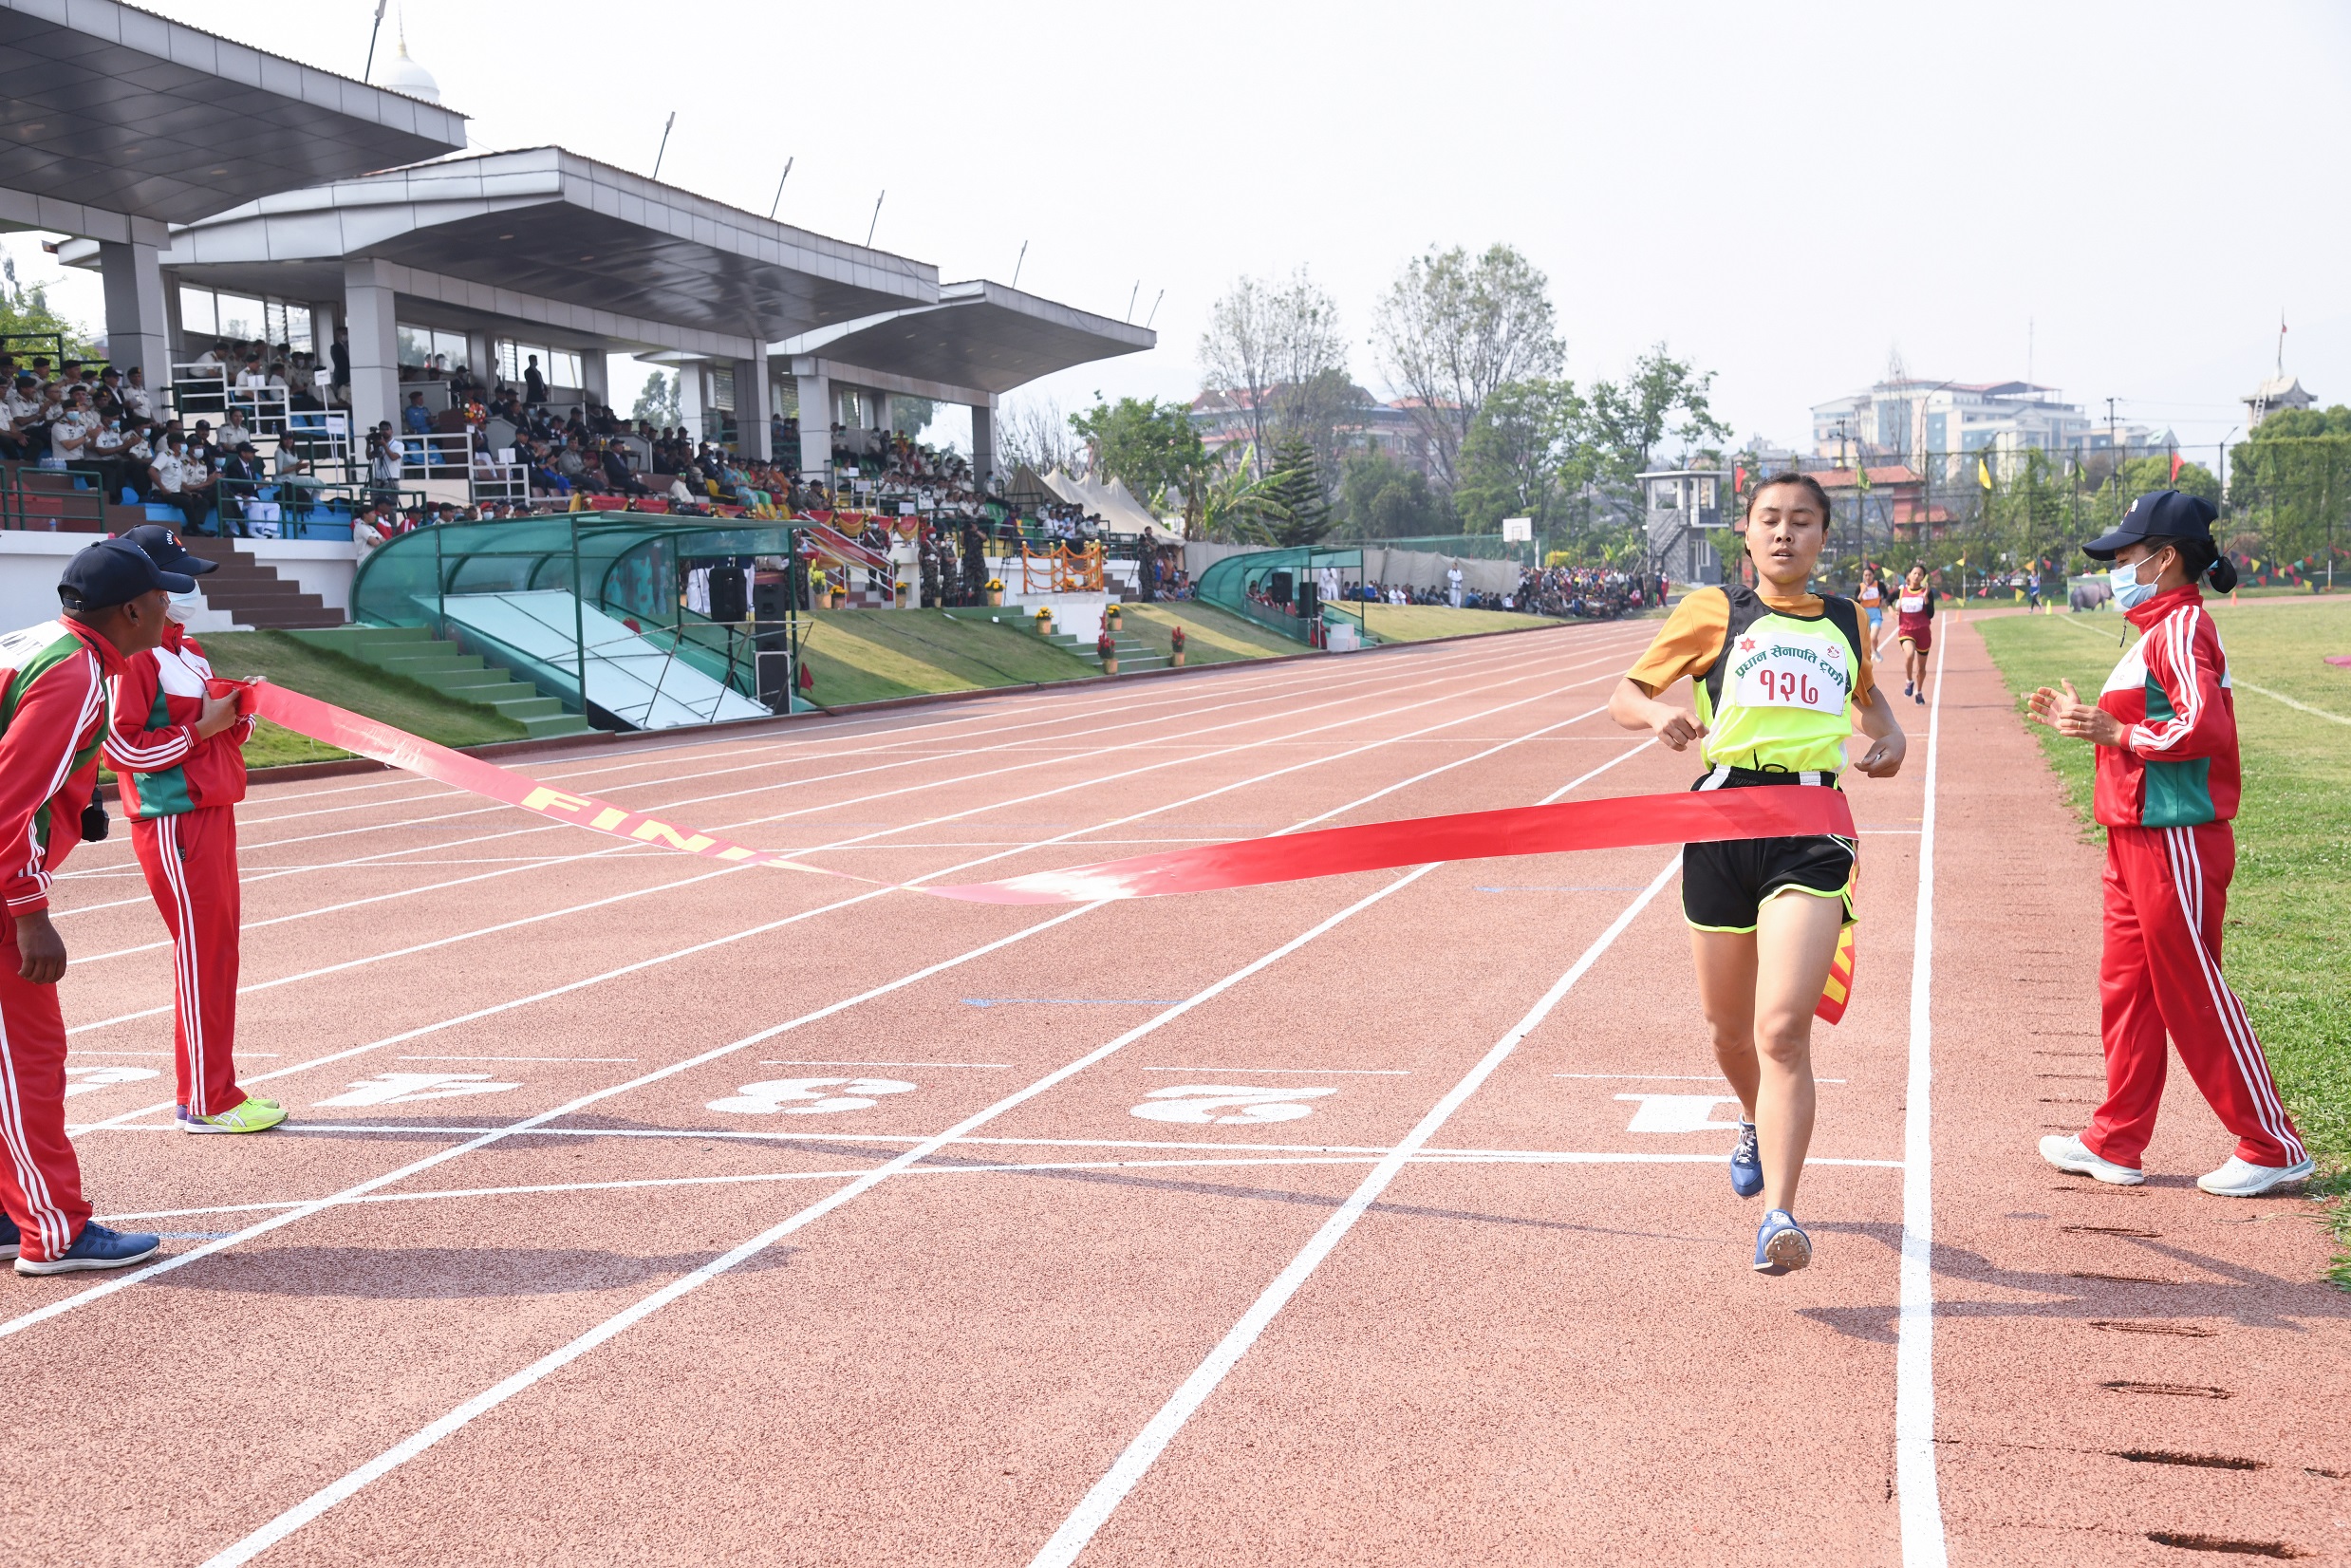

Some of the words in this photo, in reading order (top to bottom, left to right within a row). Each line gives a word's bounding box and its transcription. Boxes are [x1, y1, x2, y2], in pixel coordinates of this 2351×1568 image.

[1735, 651, 1767, 679] प्रधान
[1770, 644, 1819, 664] सेनापति
[1760, 669, 1819, 704] १२७
[520, 786, 833, 874] FINI
[309, 1073, 525, 1107] 4
[705, 1077, 918, 1114] 3
[1129, 1084, 1340, 1125] 2
